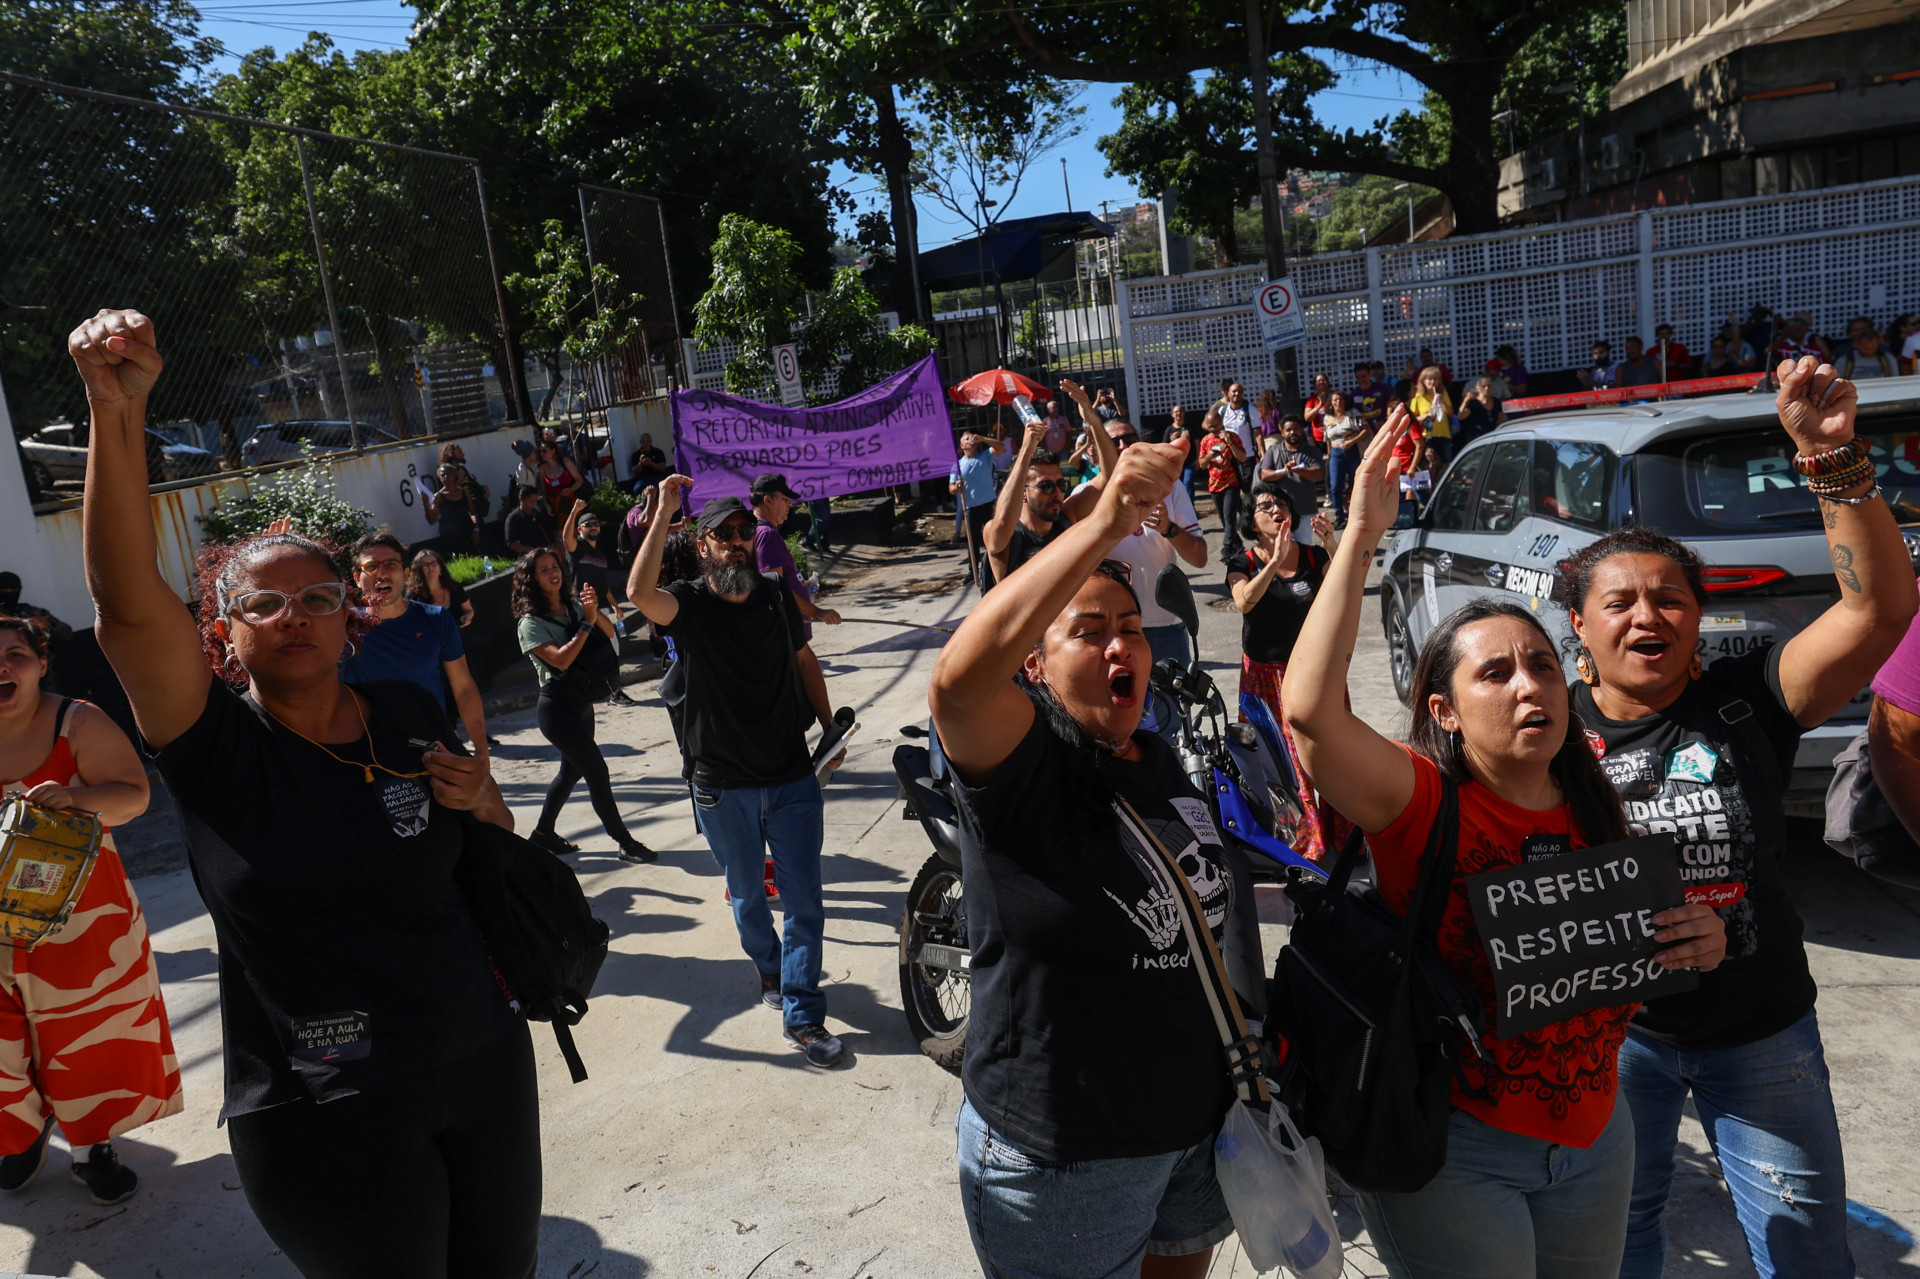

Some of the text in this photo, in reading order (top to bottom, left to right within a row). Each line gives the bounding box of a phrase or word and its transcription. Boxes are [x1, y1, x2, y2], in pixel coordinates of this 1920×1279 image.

[1268, 290, 1282, 310] E
[783, 355, 792, 374] E
[692, 414, 793, 445] REFORMA
[804, 393, 936, 435] ADMINISTRATIVA
[695, 434, 882, 474] DE EDUARDO PAES
[848, 457, 931, 489] COMBATE
[1528, 533, 1559, 558] 190
[1506, 566, 1554, 600] RECOM 90
[1612, 769, 1655, 784] GREVE!
[383, 790, 410, 802] PACOTE
[386, 792, 426, 808] MALDADES!
[1531, 843, 1560, 853] NÃO AO
[1682, 844, 1730, 865] COM
[1486, 857, 1639, 918] PREFEITO
[1489, 908, 1656, 970] RESPEITE
[923, 946, 948, 965] YAMAHA
[1132, 946, 1190, 969] i need
[1507, 958, 1690, 1018] PROFESSO
[298, 1022, 364, 1039] HOJE A AULA
[317, 1038, 332, 1047] NA
[335, 1033, 359, 1045] RUA!
